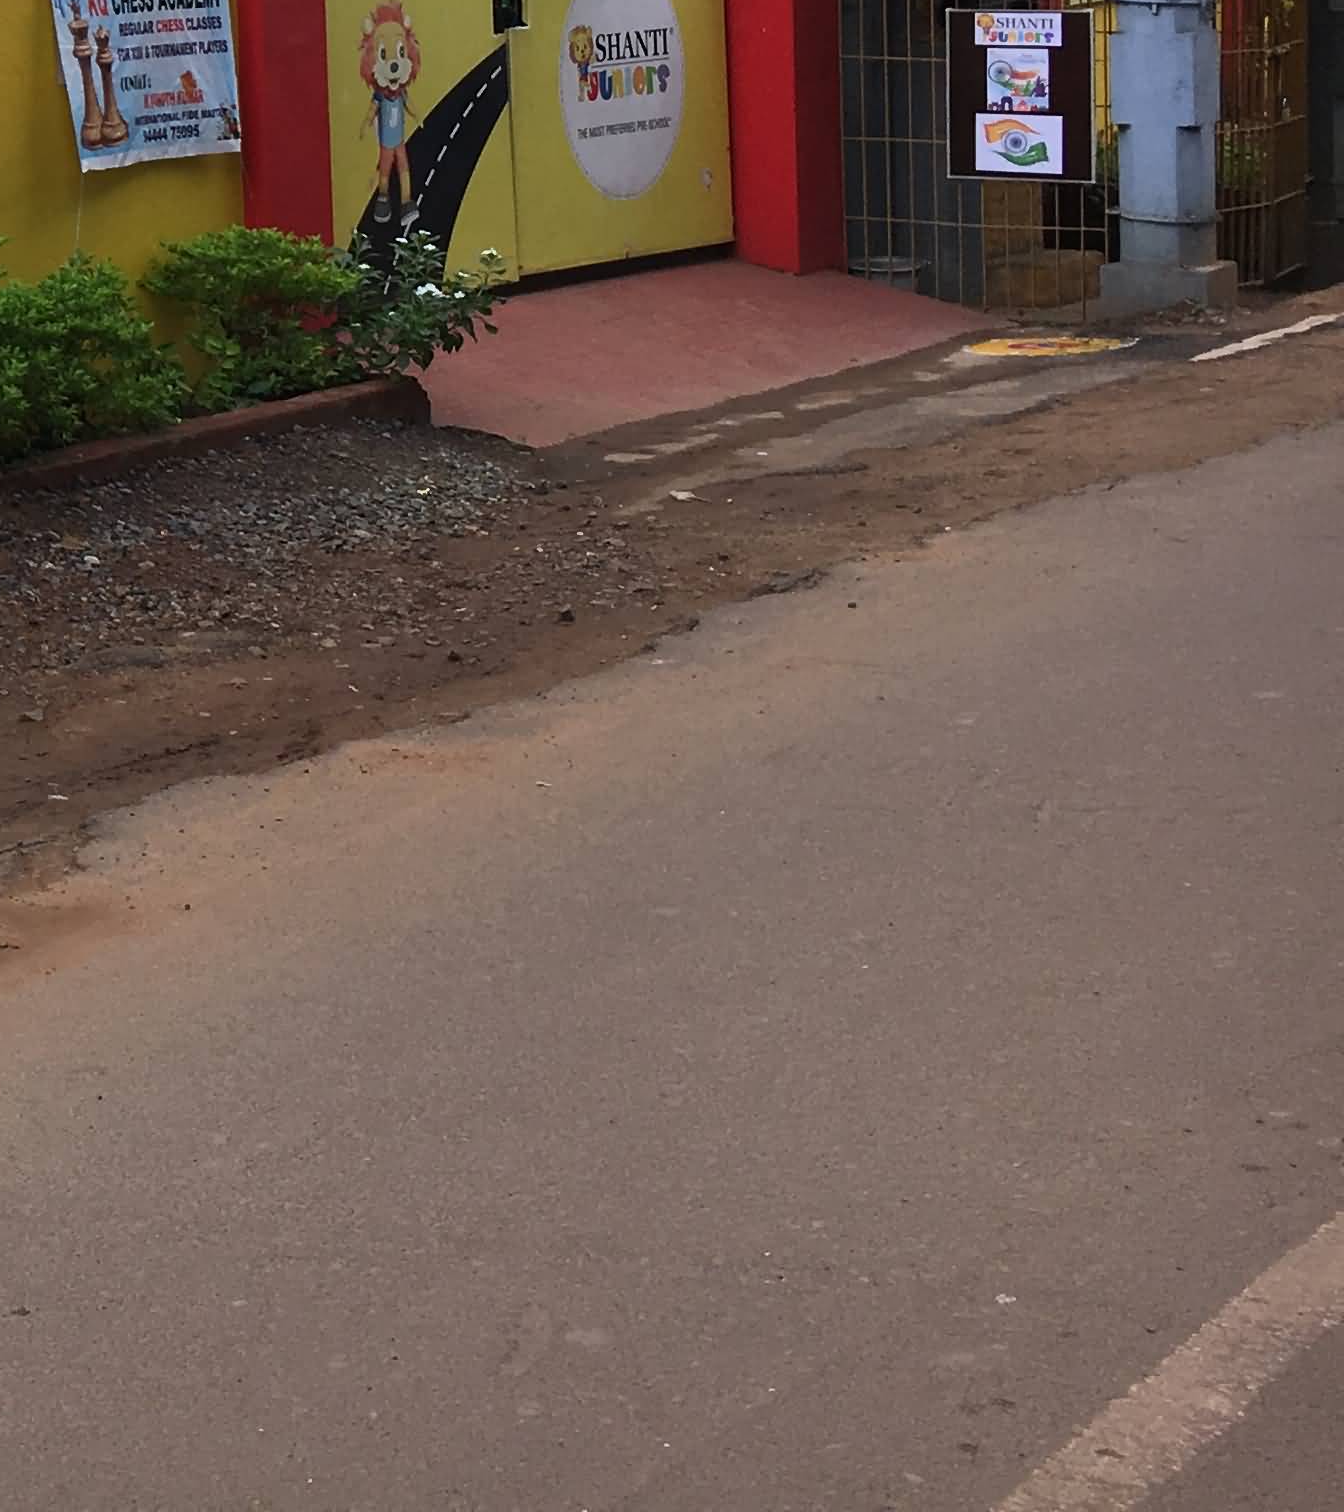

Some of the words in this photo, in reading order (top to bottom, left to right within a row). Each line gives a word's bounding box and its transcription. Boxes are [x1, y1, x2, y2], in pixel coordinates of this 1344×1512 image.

[119, 20, 154, 37] REGULAR
[156, 18, 184, 34] CHESS
[186, 16, 222, 31] CLASSES
[996, 17, 1054, 30] SHANTI
[151, 43, 197, 59] TOURNAMENT
[199, 39, 228, 55] PLAYERS
[595, 27, 669, 63] SHANTI
